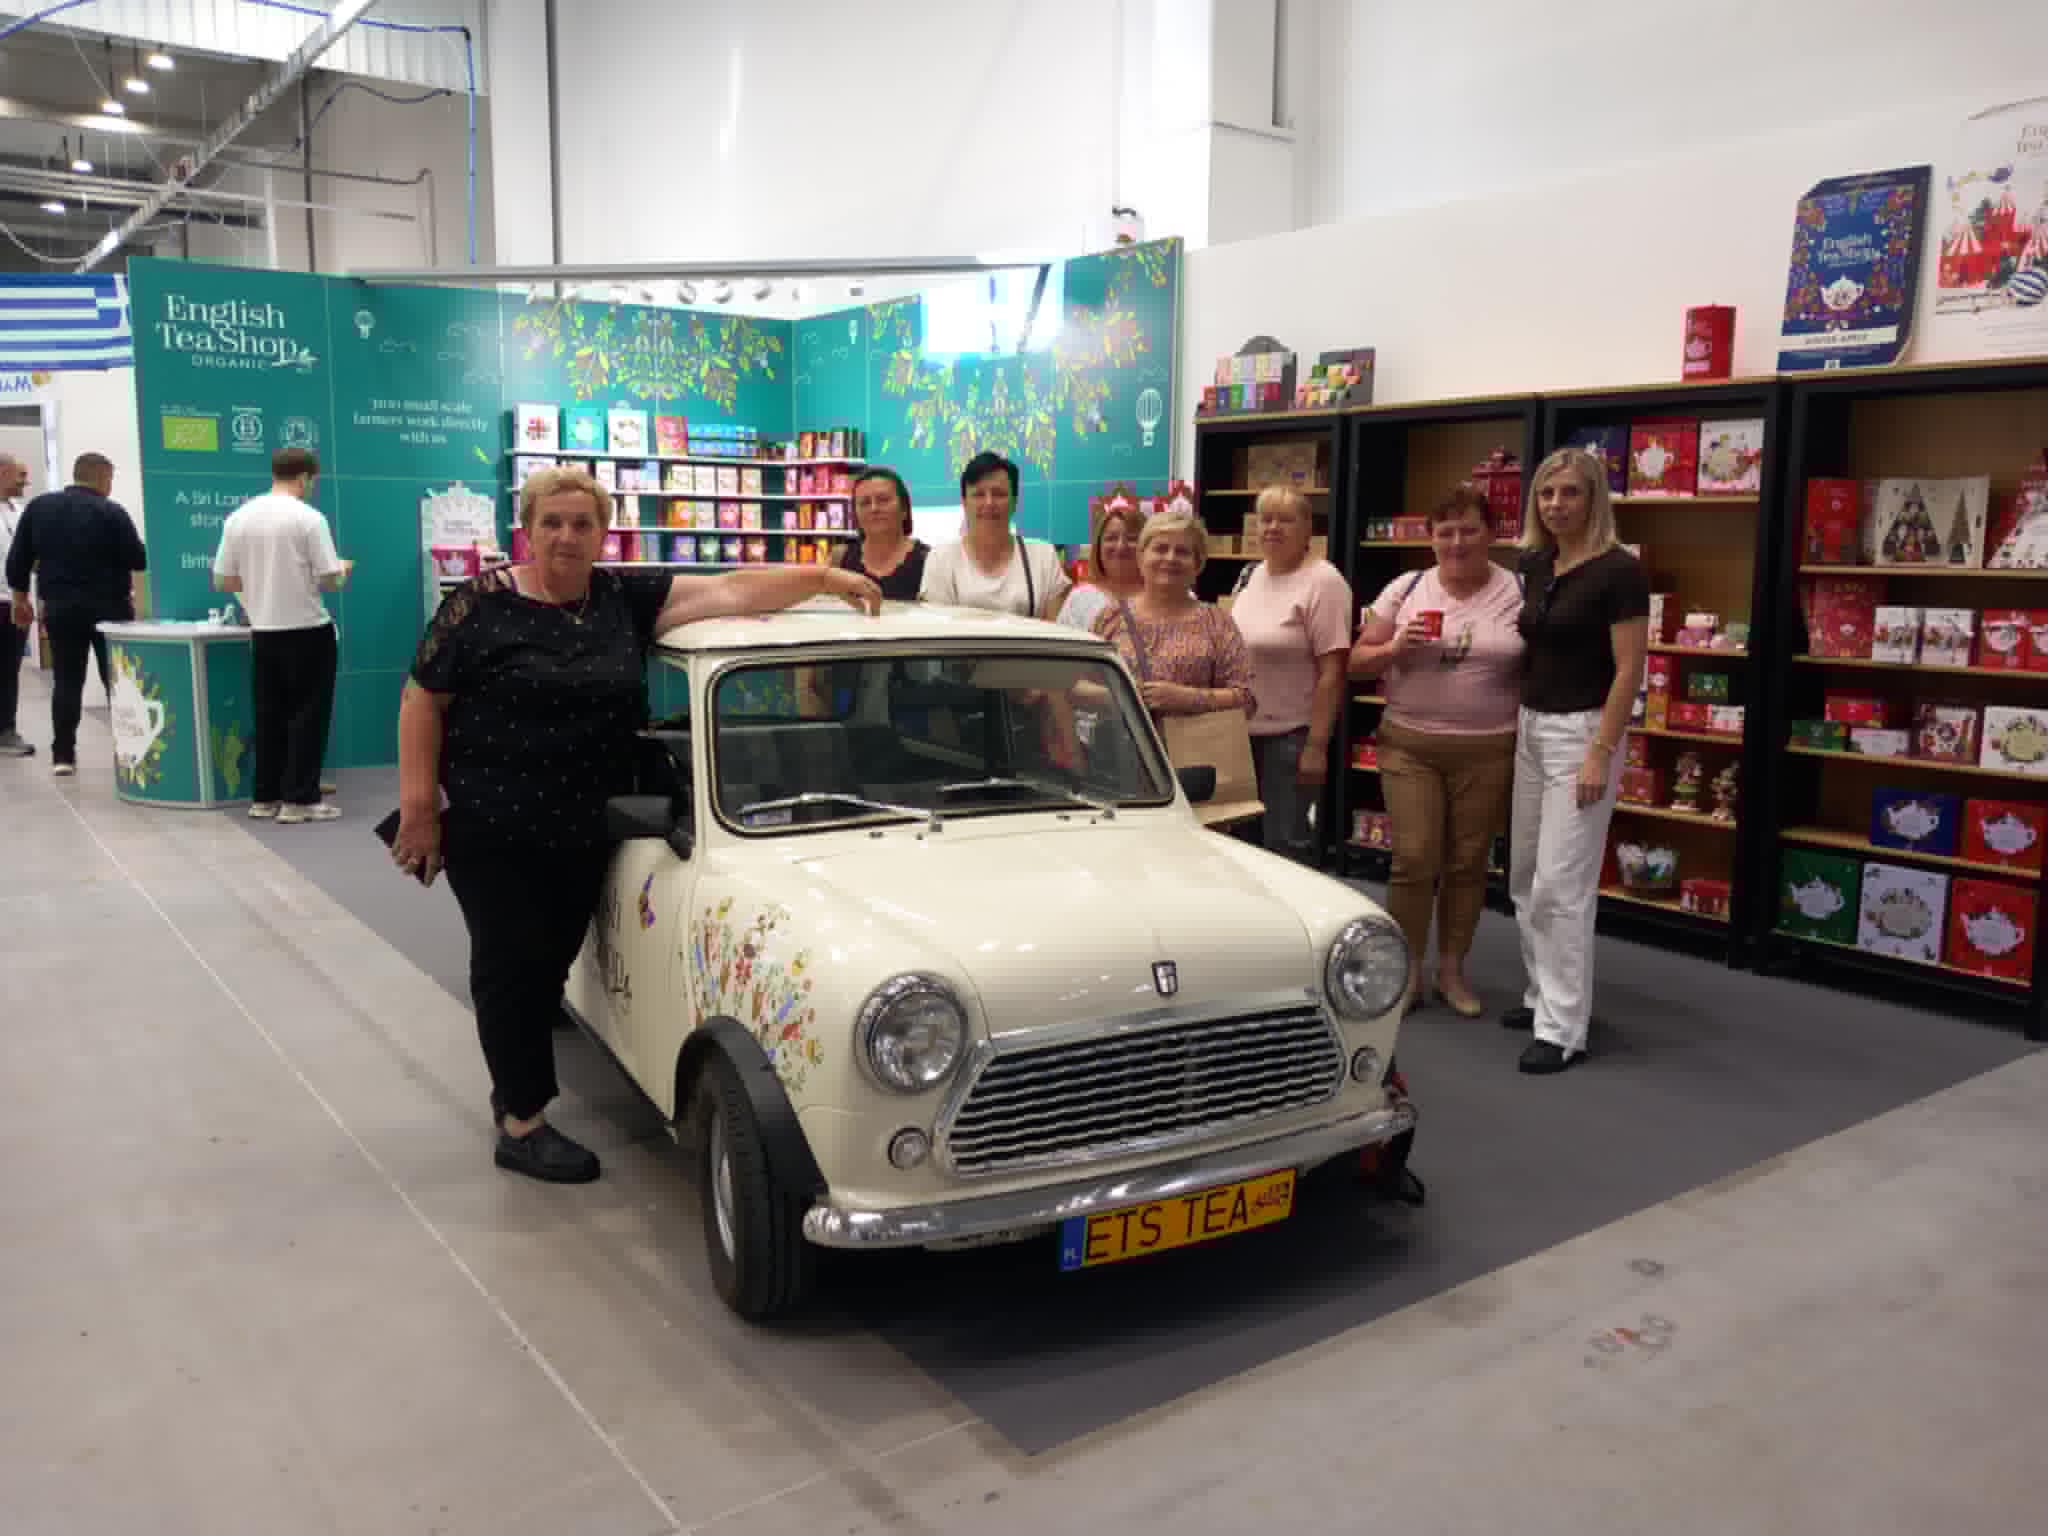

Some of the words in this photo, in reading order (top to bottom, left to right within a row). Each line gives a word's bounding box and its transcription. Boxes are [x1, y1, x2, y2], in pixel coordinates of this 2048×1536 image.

[166, 294, 286, 329] English
[191, 354, 268, 371] ORGANIC
[215, 490, 248, 507] Lan
[1087, 1205, 1162, 1260] ETS
[1182, 1185, 1249, 1240] TEA
